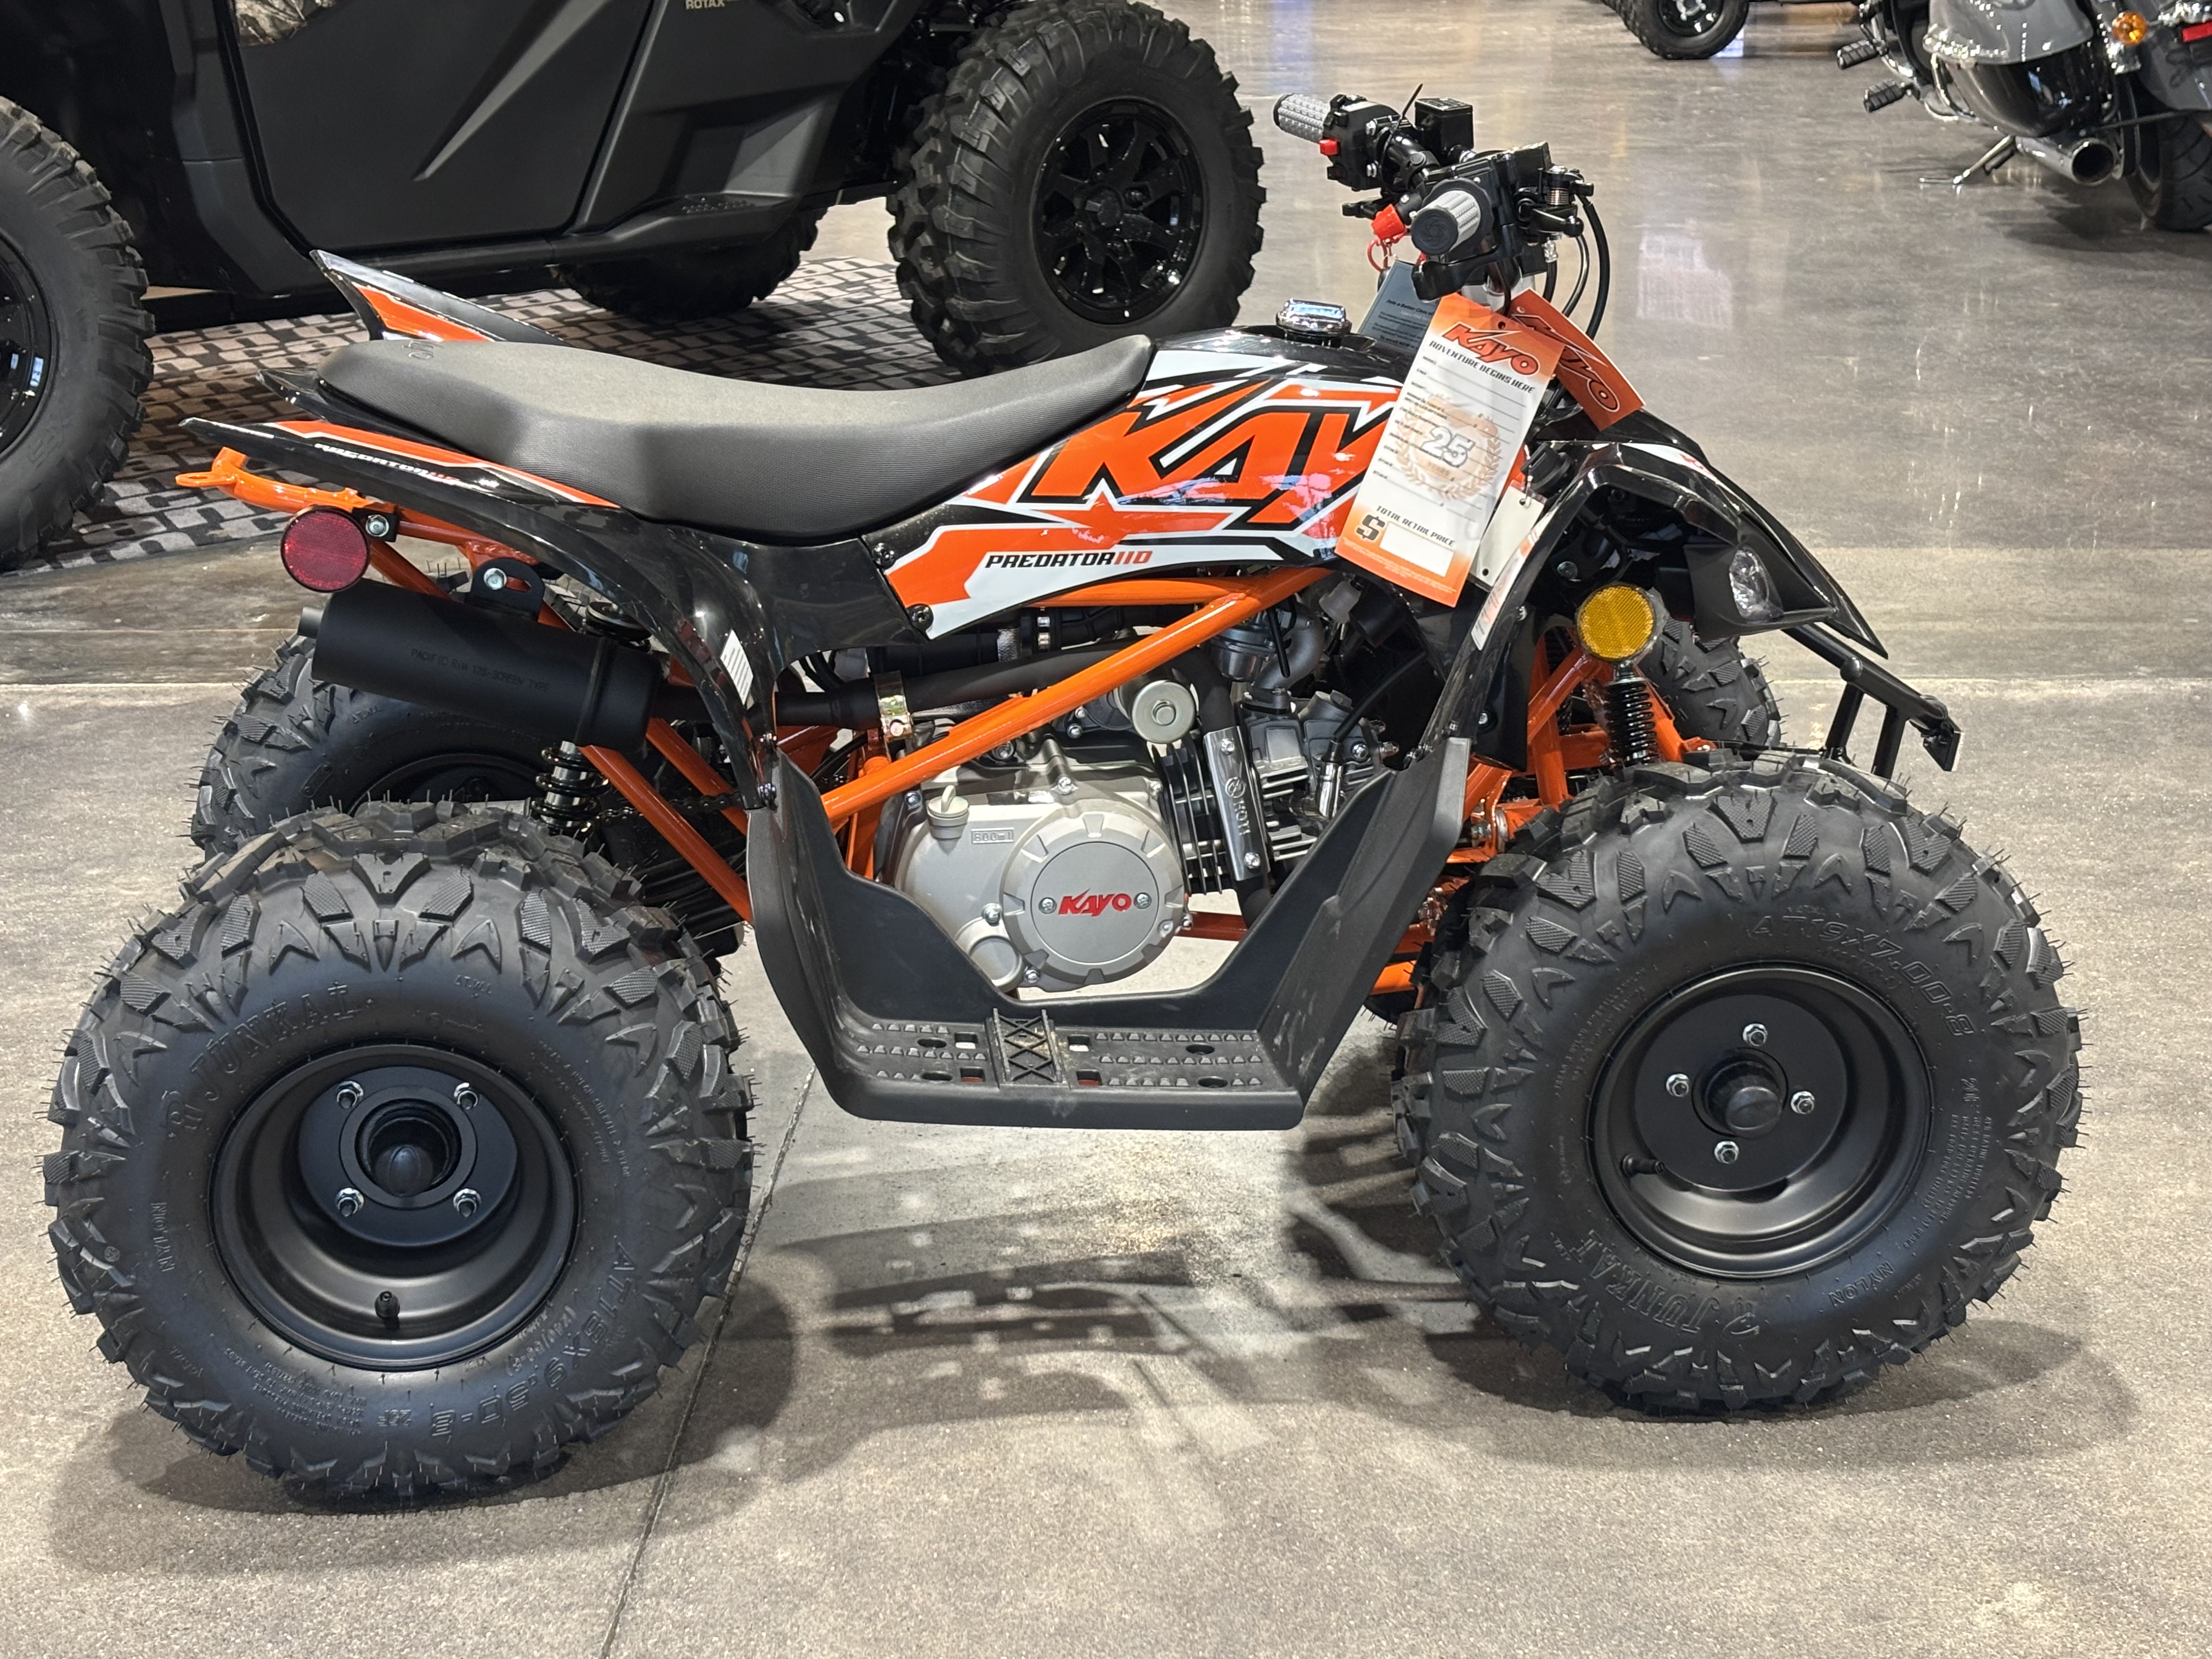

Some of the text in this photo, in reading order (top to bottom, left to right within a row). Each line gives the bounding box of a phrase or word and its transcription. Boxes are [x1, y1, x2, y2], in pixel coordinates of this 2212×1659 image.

[686, 0, 725, 9] ROTAX
[1429, 340, 1536, 394] ADVENTURE BEGINS HERE
[1442, 321, 1539, 376] KAYO
[1421, 426, 1476, 468] 25
[1356, 514, 1386, 541] $
[1376, 505, 1455, 546] TOTAL RETAIL PRICE
[411, 647, 449, 666] PACIFIC
[1058, 888, 1131, 917] KAYO
[189, 984, 356, 1101] JUNKAI
[150, 1201, 175, 1272] NYLON
[1568, 1229, 1720, 1334] JUNKAI
[1827, 1260, 1895, 1306] NYLON
